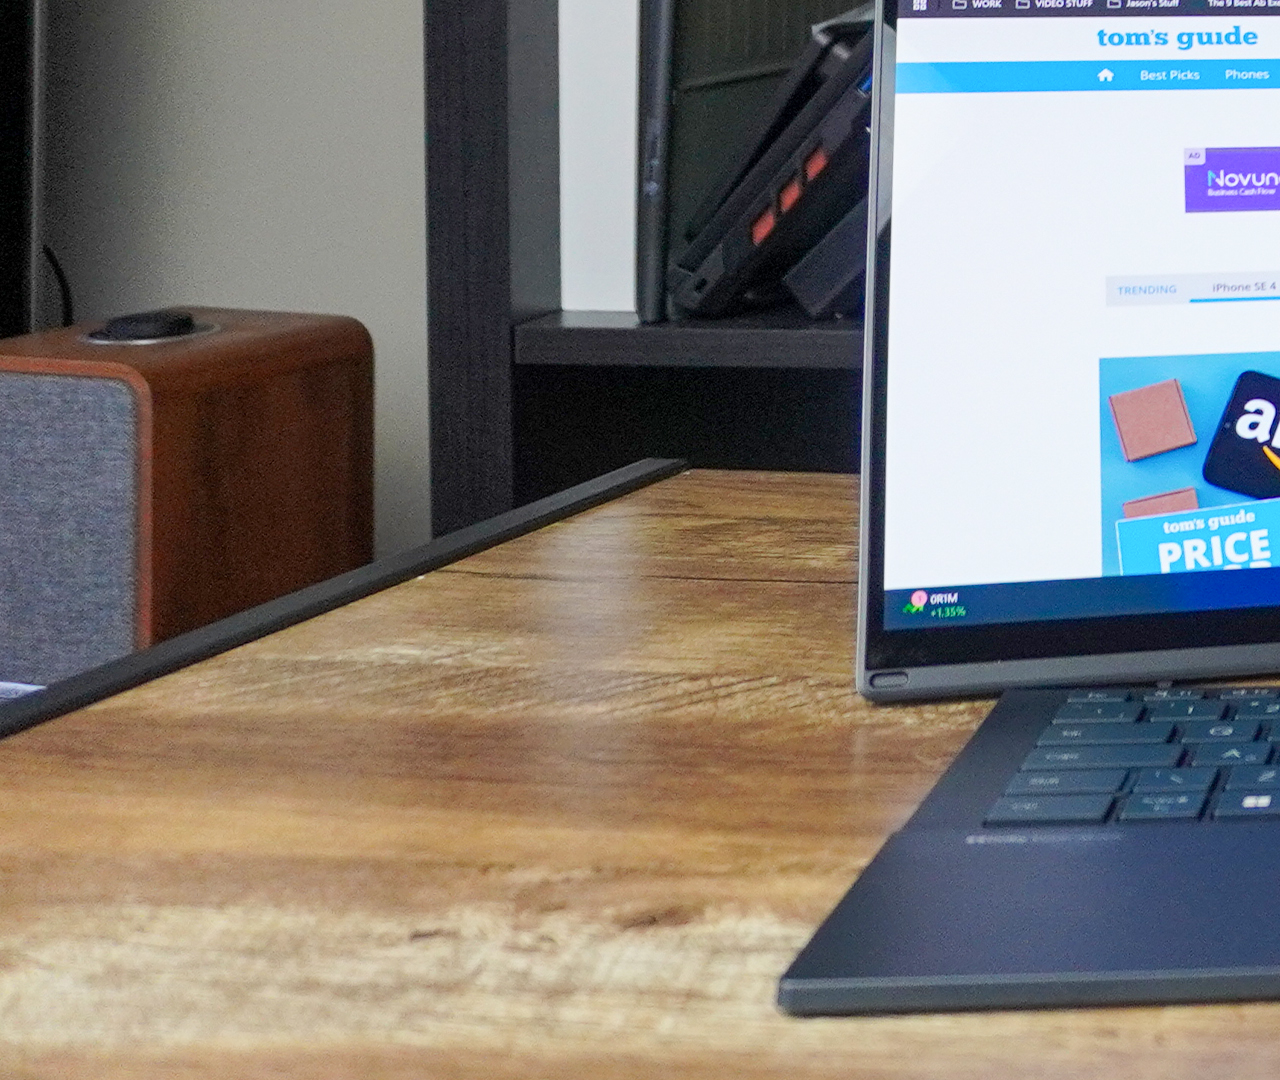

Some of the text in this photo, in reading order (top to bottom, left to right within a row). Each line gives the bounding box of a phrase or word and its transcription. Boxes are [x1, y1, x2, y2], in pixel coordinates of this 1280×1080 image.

[972, 0, 1002, 8] WORK
[1035, 0, 1093, 8] VIDEO STUFF
[1097, 26, 1258, 51] tom's guide
[1140, 69, 1200, 81] Best Picks
[1225, 69, 1270, 81] Phones
[1208, 188, 1239, 196] Business
[1117, 285, 1177, 296] TRENDING
[1212, 281, 1277, 293] iPhone SE 4
[1163, 510, 1256, 535] tom's guide
[1158, 529, 1272, 575] PRICE
